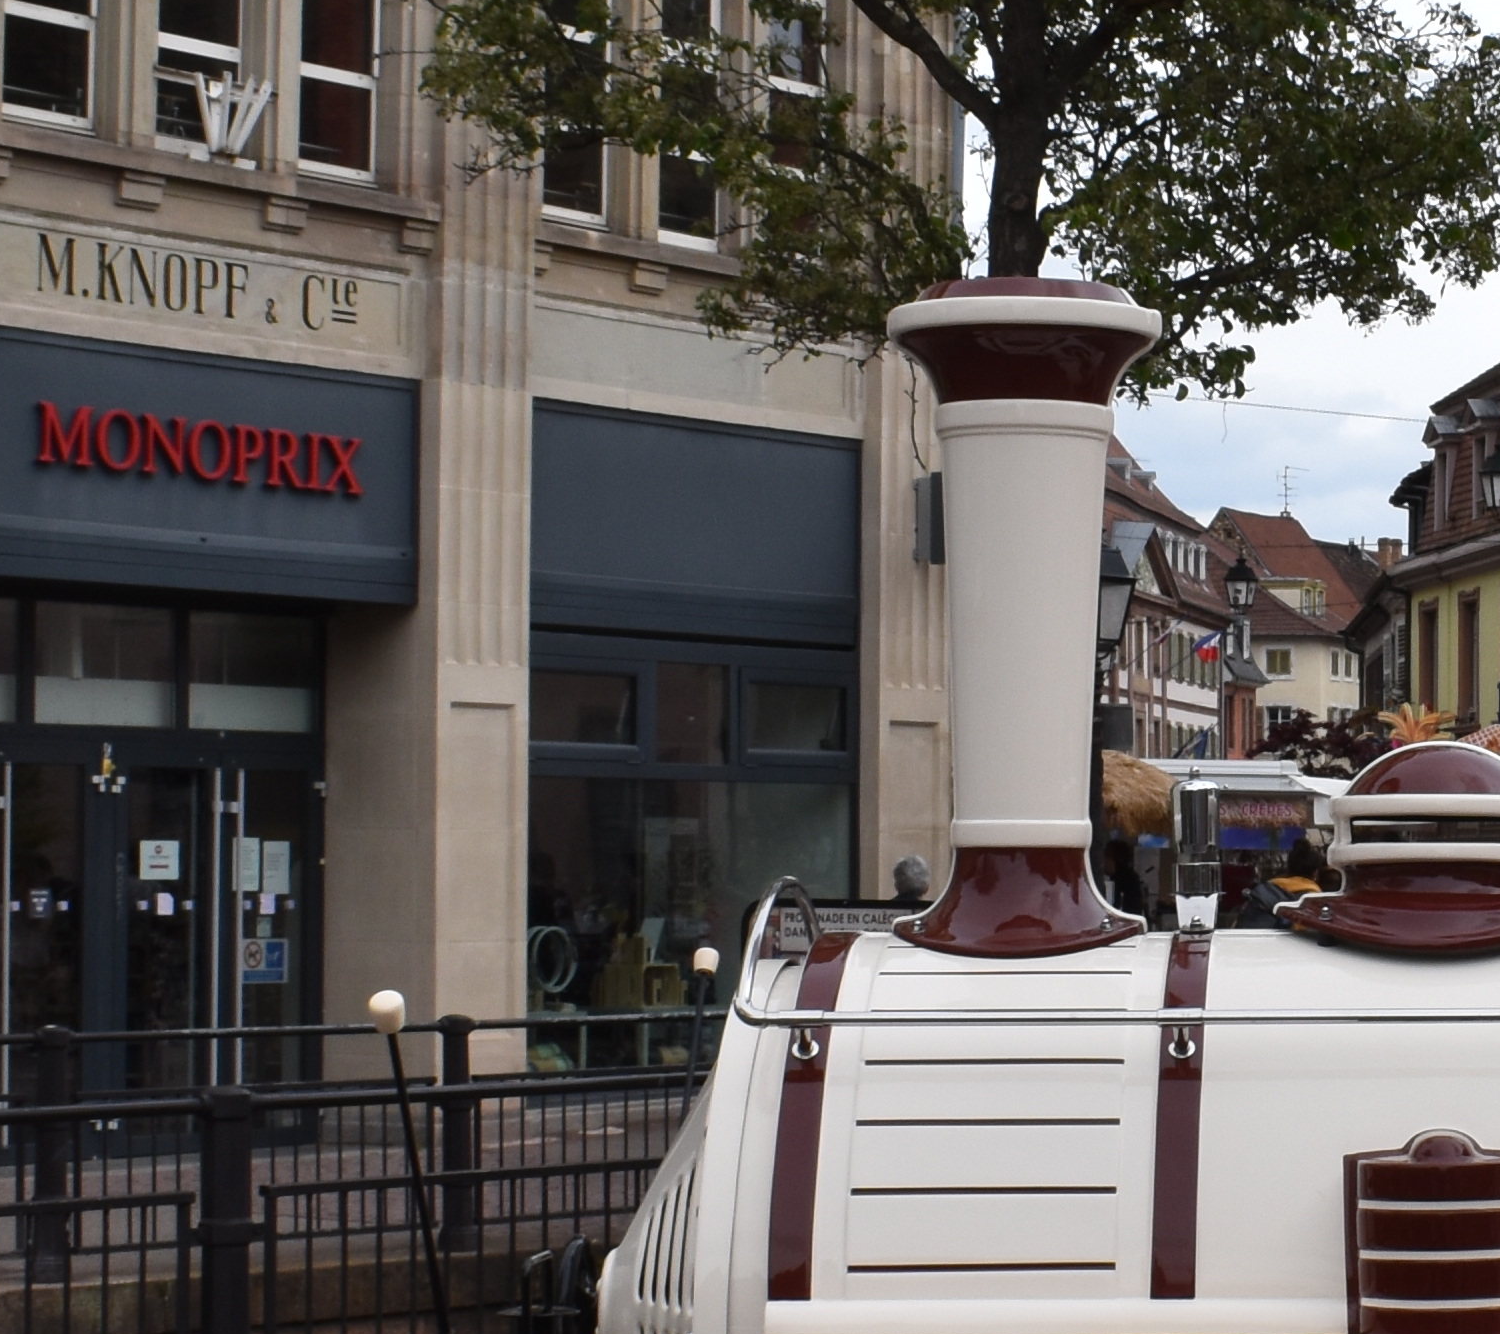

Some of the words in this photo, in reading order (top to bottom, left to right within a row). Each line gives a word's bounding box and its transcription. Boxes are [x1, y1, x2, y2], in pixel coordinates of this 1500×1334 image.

[265, 298, 278, 324] &
[36, 400, 364, 496] MONOPRIX
[785, 913, 844, 923] PRONADE
[848, 913, 859, 924] EN
